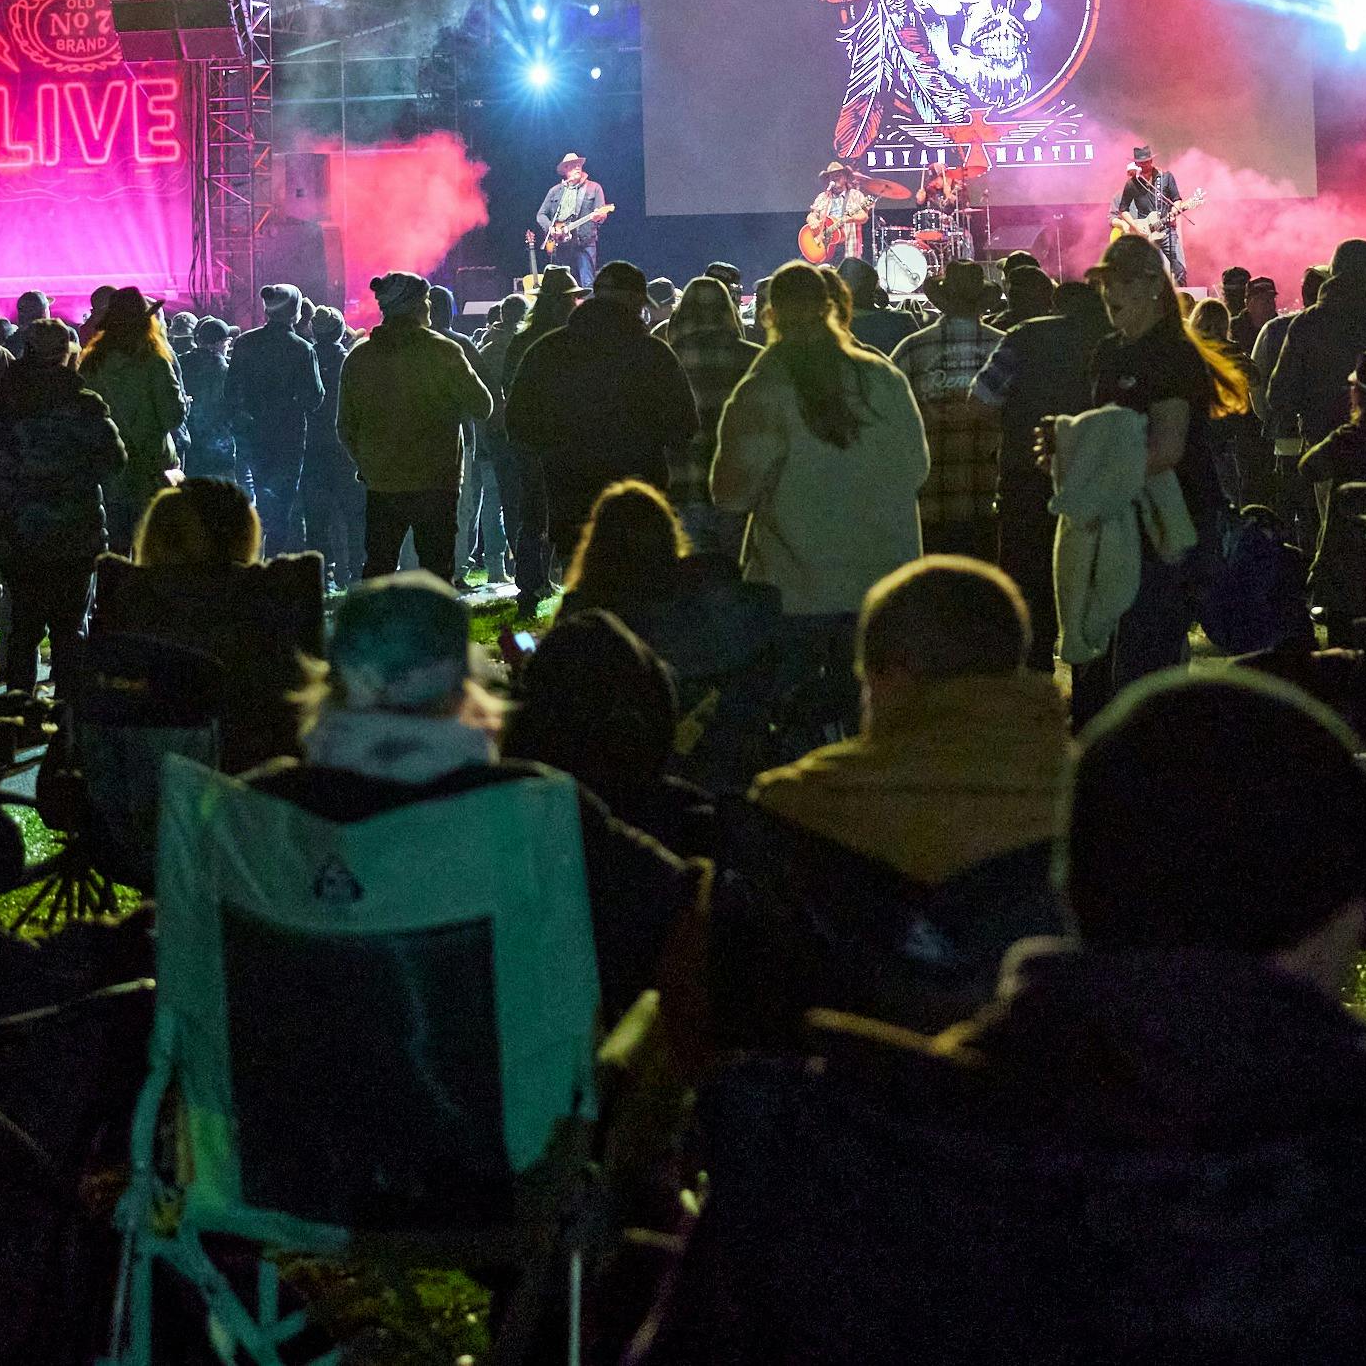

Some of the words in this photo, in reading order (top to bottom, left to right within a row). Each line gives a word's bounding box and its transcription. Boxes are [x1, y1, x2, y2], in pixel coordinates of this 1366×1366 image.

[95, 9, 113, 34] 7
[56, 36, 108, 52] BRAND
[866, 148, 946, 168] BRYAN
[995, 143, 1094, 163] MARTIN
